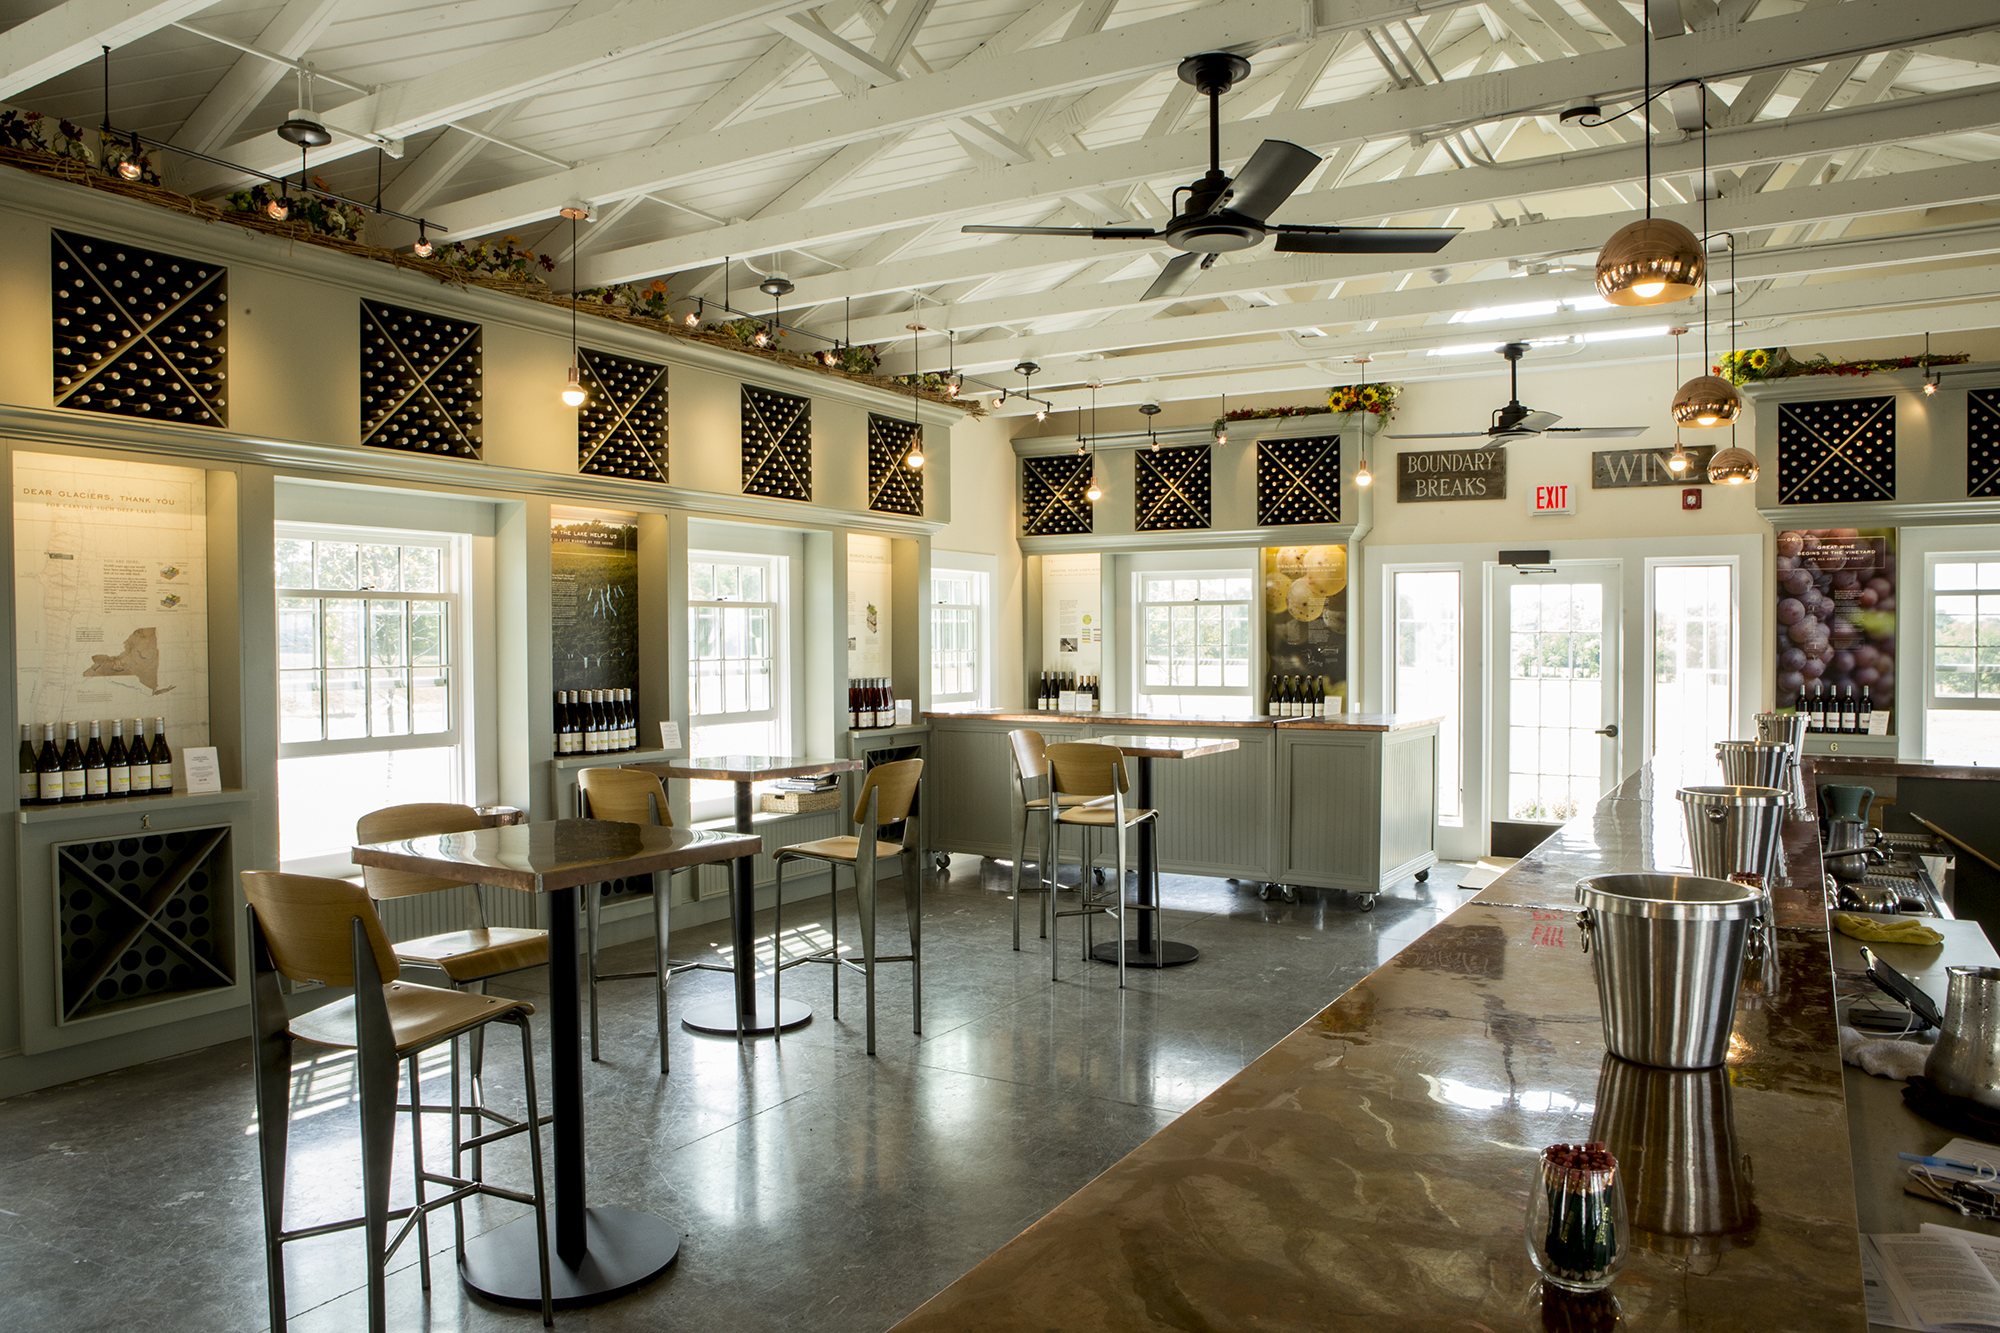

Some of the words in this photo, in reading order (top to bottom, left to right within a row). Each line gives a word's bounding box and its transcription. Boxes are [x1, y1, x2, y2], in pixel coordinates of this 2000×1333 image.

[1408, 452, 1496, 474] BOUNDARY
[1602, 450, 1699, 482] WINE
[24, 488, 52, 496] DEAR
[58, 490, 114, 502] GLACIERS,
[120, 496, 151, 504] THANK
[1416, 477, 1486, 497] BREAKS
[1536, 486, 1568, 509] EXIT
[1830, 742, 1838, 751] 6
[142, 814, 152, 829] 1
